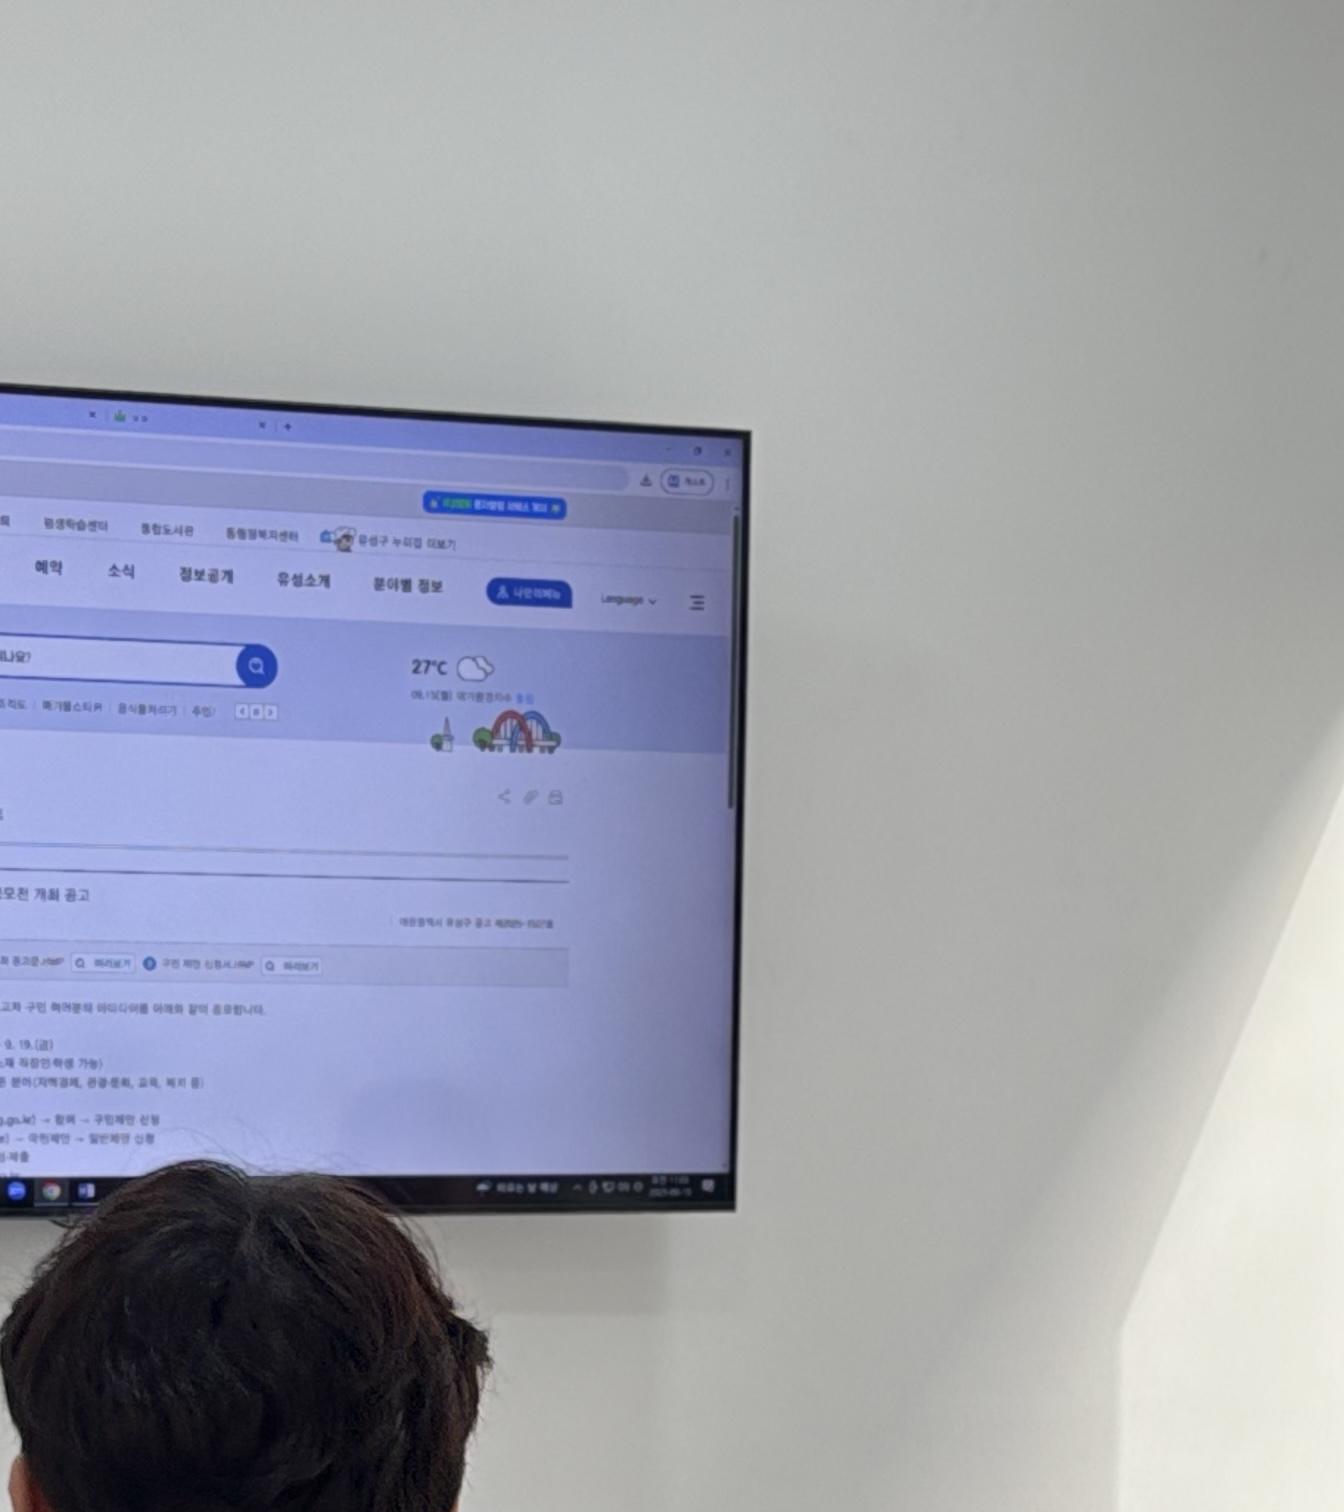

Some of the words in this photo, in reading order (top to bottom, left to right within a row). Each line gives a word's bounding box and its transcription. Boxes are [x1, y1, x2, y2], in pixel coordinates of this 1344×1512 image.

[34, 559, 63, 576] 예약
[108, 563, 136, 579] 소식
[179, 566, 234, 584] 정보공개
[277, 571, 332, 590] 유성소개
[374, 576, 413, 594] 분야별
[417, 578, 444, 594] 정보
[411, 658, 448, 676] 27°C
[64, 887, 90, 903] 공고
